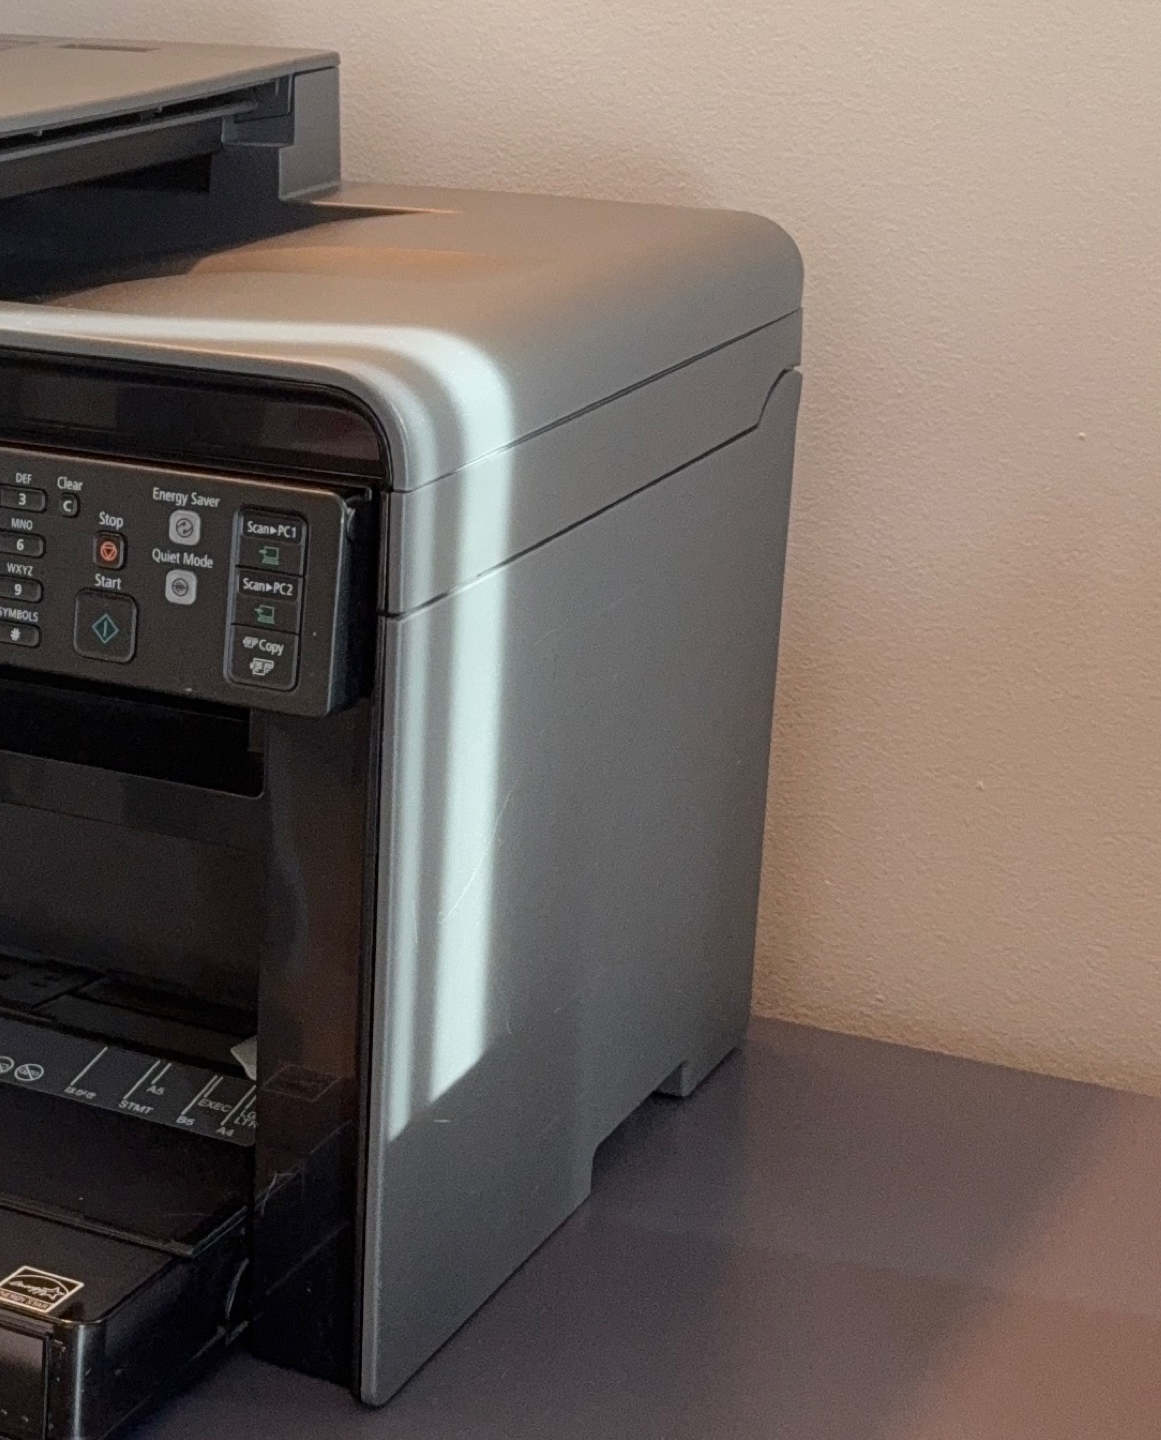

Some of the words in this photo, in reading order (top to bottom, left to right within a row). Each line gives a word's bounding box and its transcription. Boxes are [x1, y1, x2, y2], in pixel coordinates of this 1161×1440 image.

[16, 472, 33, 485] DEF
[57, 476, 83, 491] Clear
[18, 493, 26, 505] 3
[152, 487, 188, 506] Energy
[191, 492, 220, 508] Saver
[63, 500, 72, 512] C
[11, 518, 33, 531] MNO
[99, 511, 124, 529] Stop
[16, 539, 25, 551] 6
[152, 548, 180, 565] Quiet
[182, 553, 213, 569] Mode
[7, 562, 34, 576] WXYZ
[94, 573, 122, 590] Start
[14, 583, 22, 595] 9
[259, 638, 284, 656] Copy
[146, 1084, 165, 1095] A5
[118, 1100, 154, 1115] STMT
[197, 1098, 232, 1113] EXEC
[176, 1115, 195, 1126] B5
[216, 1126, 234, 1137] A4
